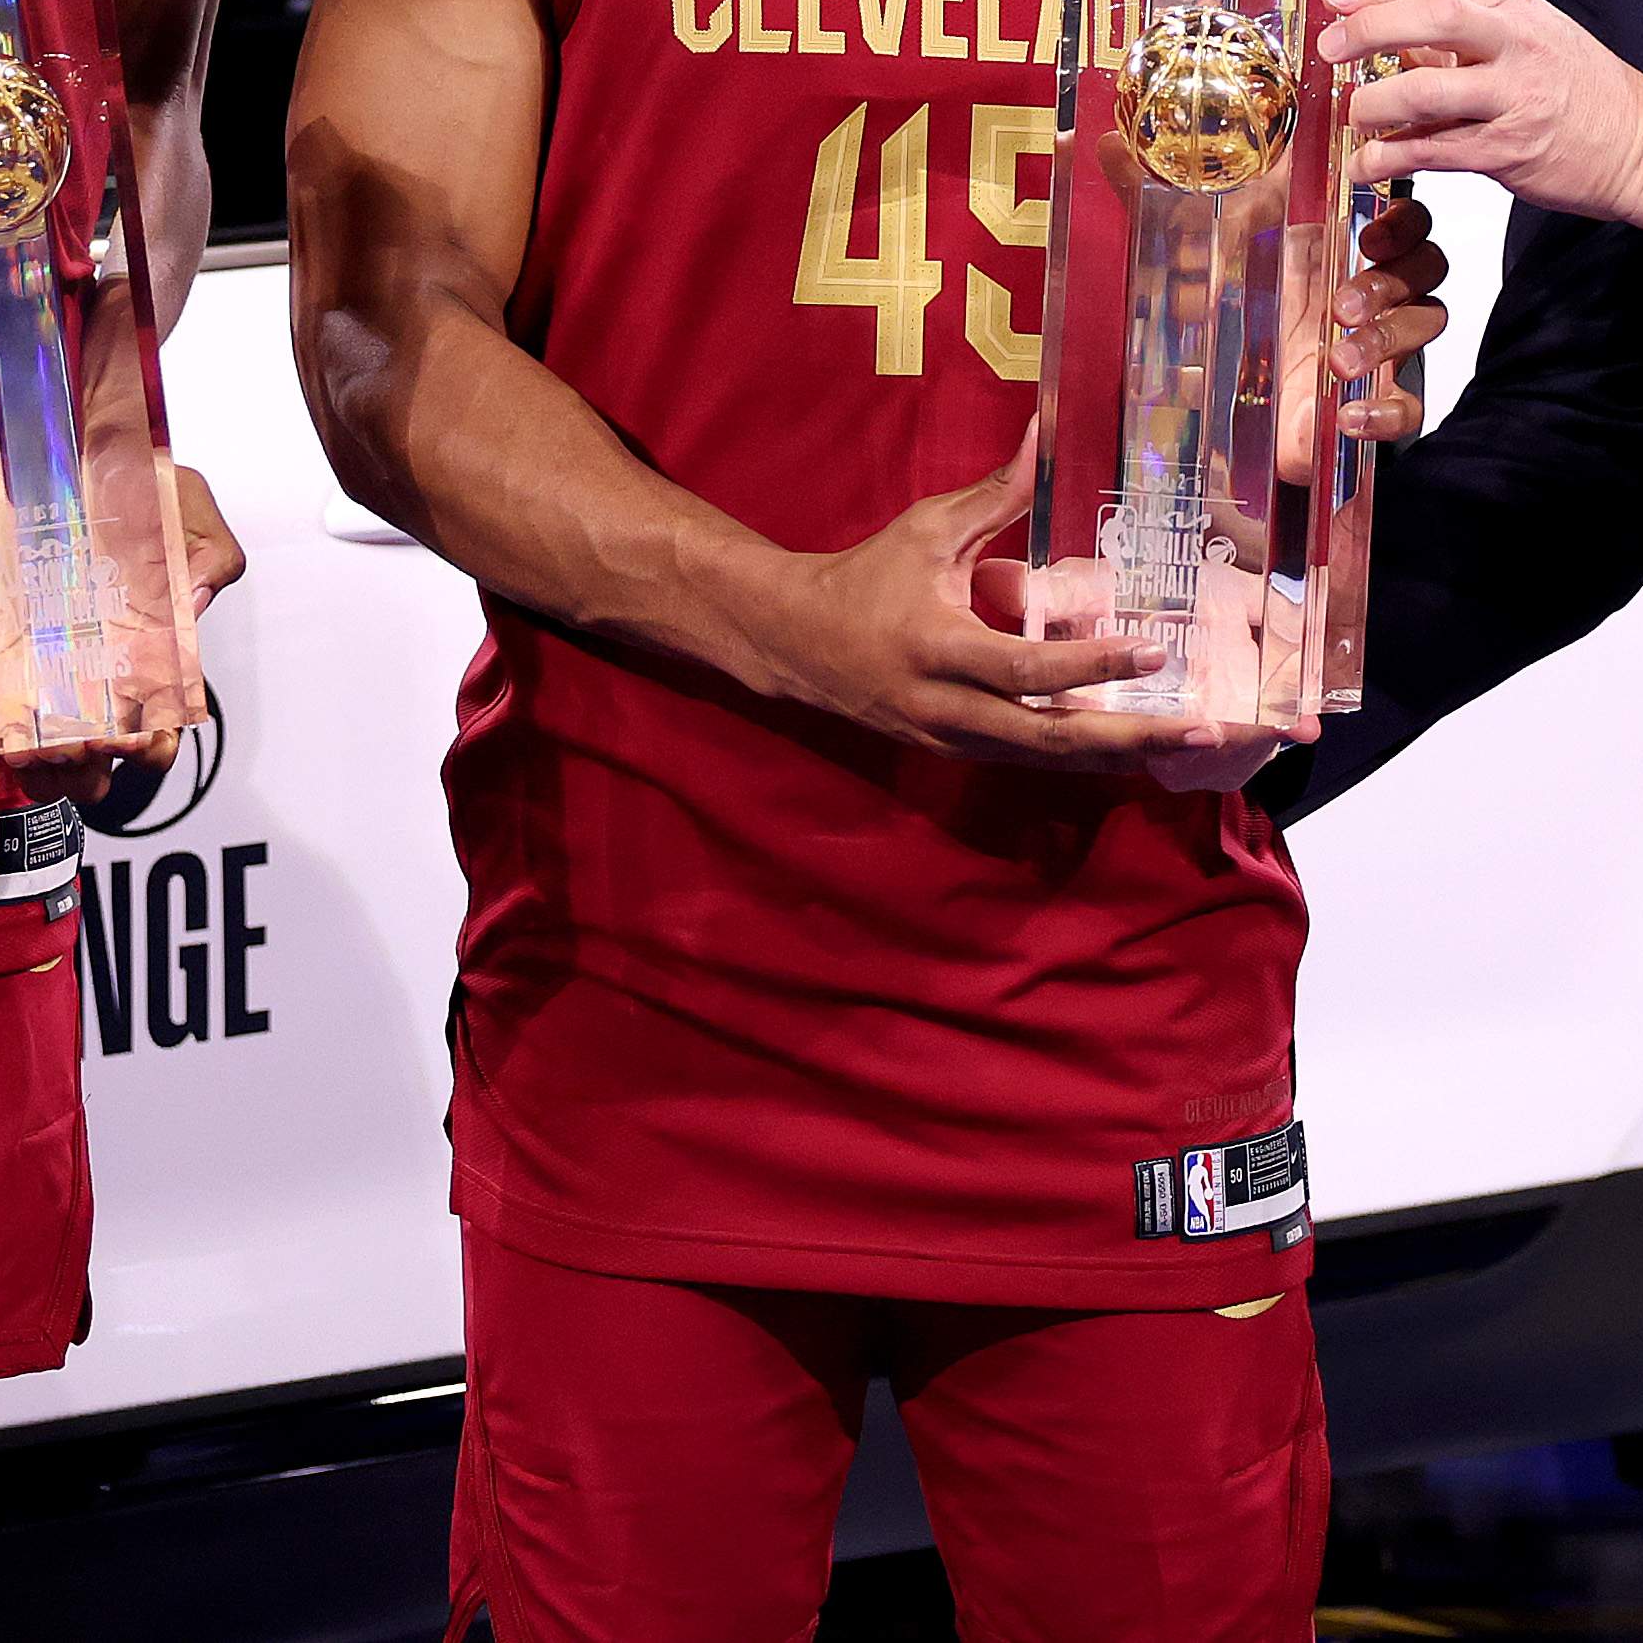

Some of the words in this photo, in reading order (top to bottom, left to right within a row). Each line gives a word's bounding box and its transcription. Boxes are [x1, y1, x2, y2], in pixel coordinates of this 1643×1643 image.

[793, 102, 1057, 383] 45
[83, 842, 270, 1057] NGE
[1229, 1167, 1243, 1184] 50
